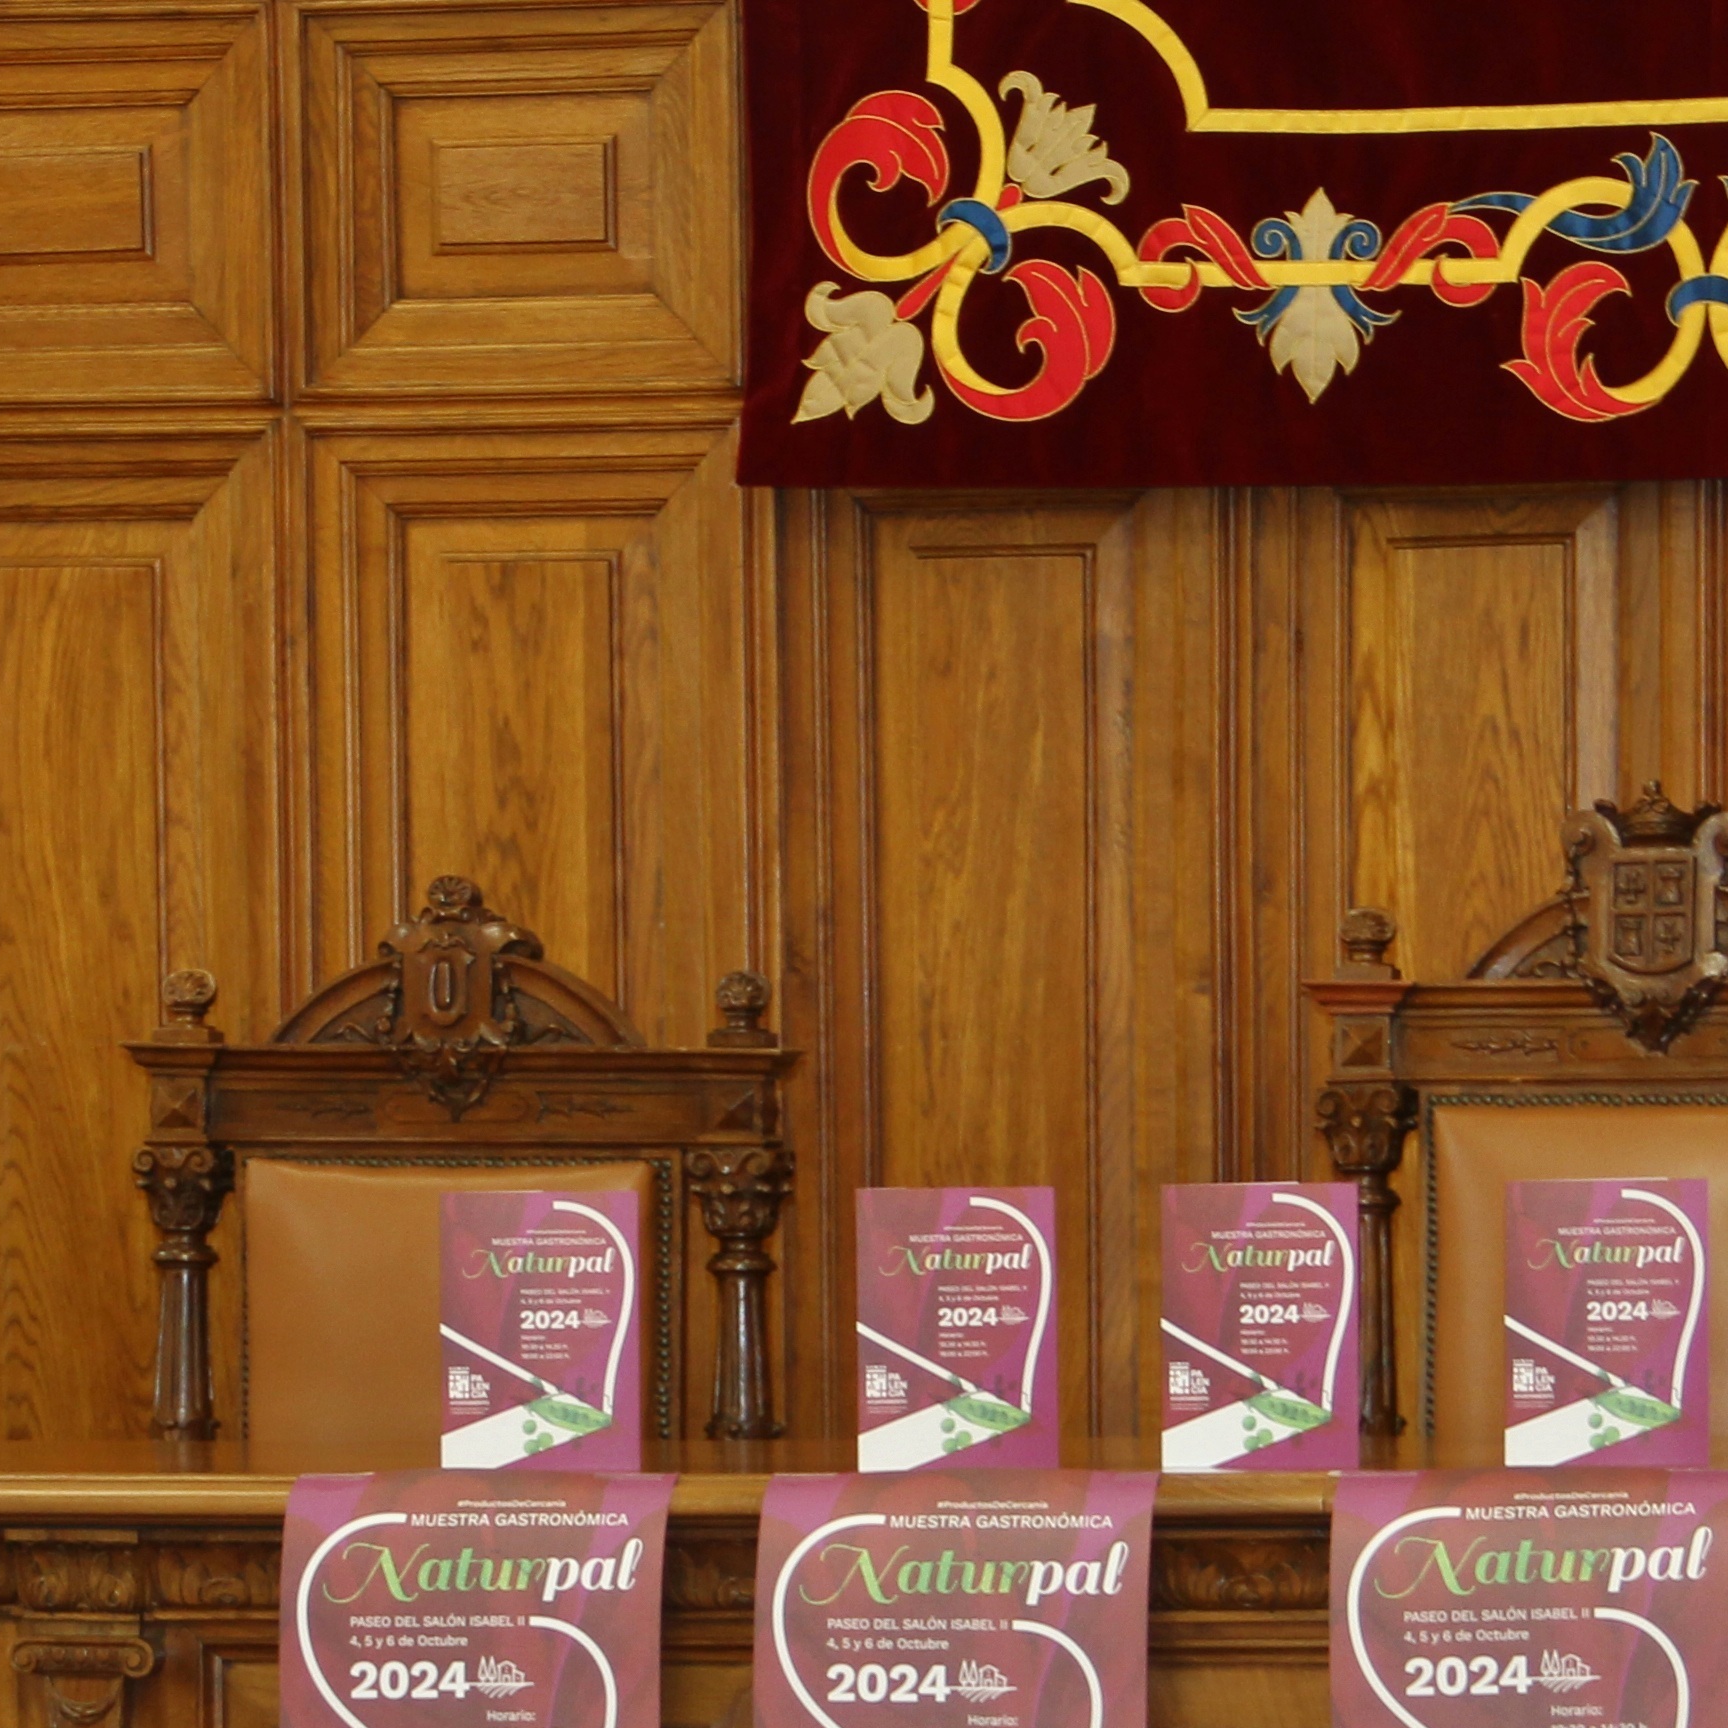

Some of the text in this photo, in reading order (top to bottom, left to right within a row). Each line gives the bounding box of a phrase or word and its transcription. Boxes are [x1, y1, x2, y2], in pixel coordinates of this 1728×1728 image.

[462, 1247, 615, 1278] Naturpal
[879, 1243, 1033, 1275] Naturpal
[1181, 1239, 1335, 1273] Naturpal
[1527, 1236, 1685, 1269] Naturpal
[520, 1310, 581, 1329] 2024
[937, 1306, 999, 1327] 2024
[1239, 1304, 1300, 1324] 2024
[1586, 1301, 1649, 1321] 2024
[411, 1511, 629, 1527] MUESTRA GASTRONÓMICA
[890, 1512, 1113, 1529] MUESTRA GASTRONÓMICA
[1465, 1501, 1696, 1521] MUESTRA GASTRONÓMICA
[323, 1537, 644, 1603] Naturpal
[1374, 1526, 1713, 1599] Naturpal
[799, 1540, 1129, 1606] Naturpal
[350, 1613, 526, 1628] PASEO DEL SALÓN ISABEL II
[827, 1616, 1008, 1630] PASEO DEL SALÓN ISABEL II
[1403, 1607, 1590, 1623] PASEO DEL SALÓN ISABEL II
[349, 1634, 468, 1650] 4, 5 y 6 de Octubre
[826, 1638, 949, 1652] 4, 5 y 6 de Octubre
[1403, 1628, 1530, 1644] 4, 5 y 6 de Octubre
[350, 1660, 471, 1700] 2024
[826, 1663, 951, 1703] 2024
[1404, 1655, 1532, 1696] 2024
[486, 1710, 536, 1721] Horario:
[967, 1715, 1019, 1726] Horario:
[1551, 1705, 1603, 1716] Horario:
